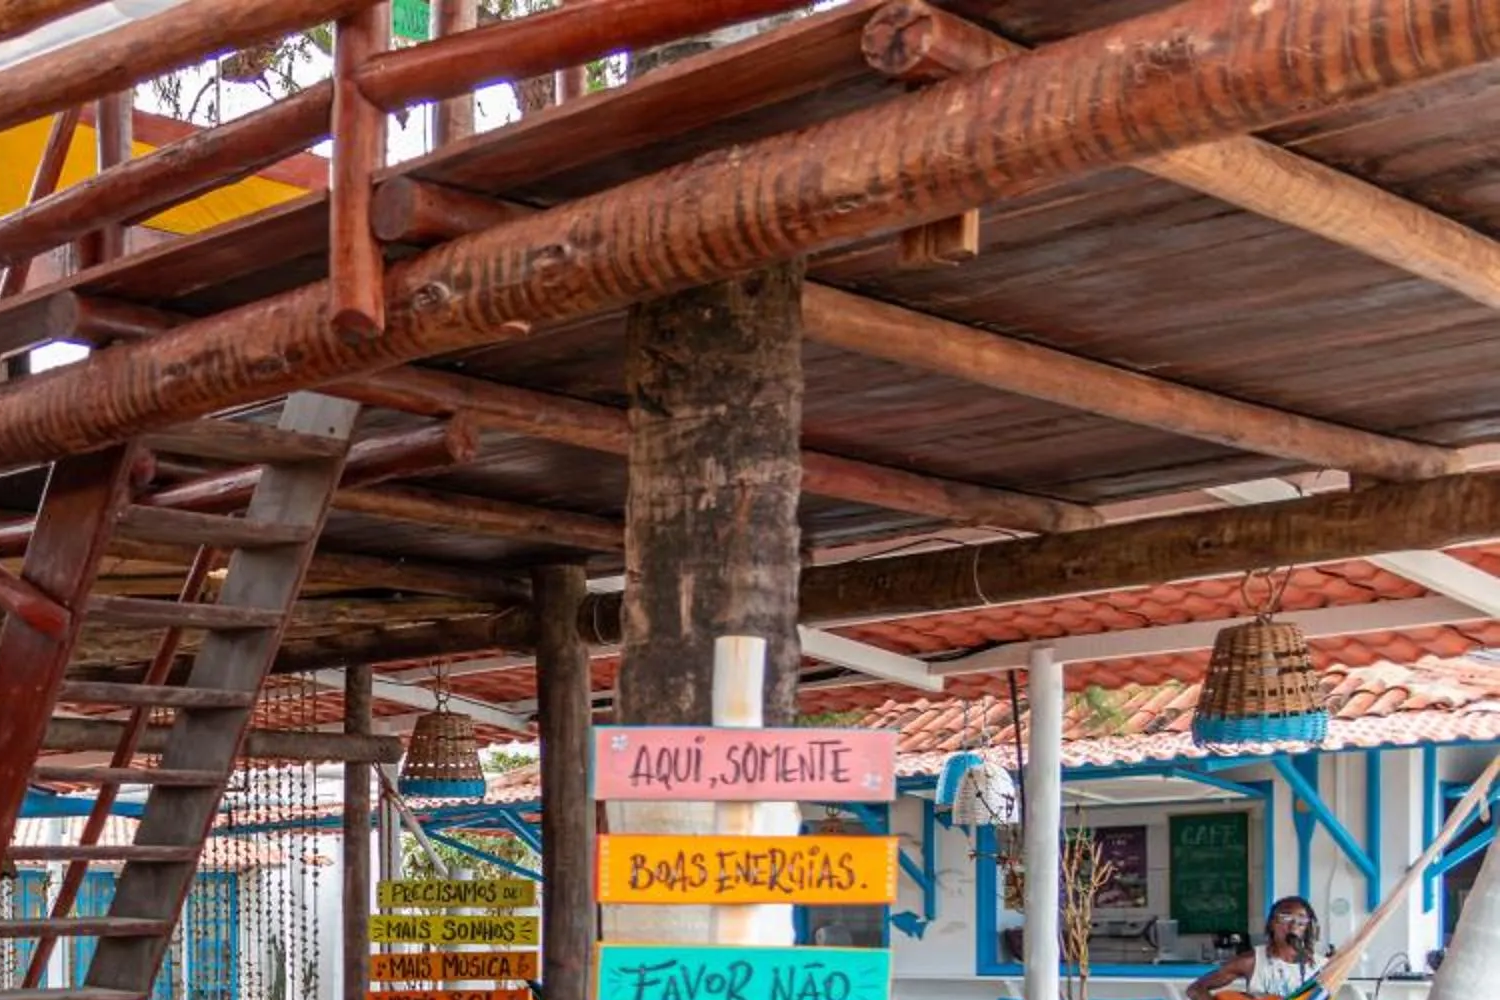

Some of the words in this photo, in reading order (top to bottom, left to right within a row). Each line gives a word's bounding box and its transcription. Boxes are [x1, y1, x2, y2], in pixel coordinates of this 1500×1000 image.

[719, 739, 853, 785] SOMENTE
[628, 850, 708, 892] BOAS
[386, 918, 432, 941] MAIS
[441, 919, 516, 942] SONHOS
[388, 955, 432, 979] MAIS
